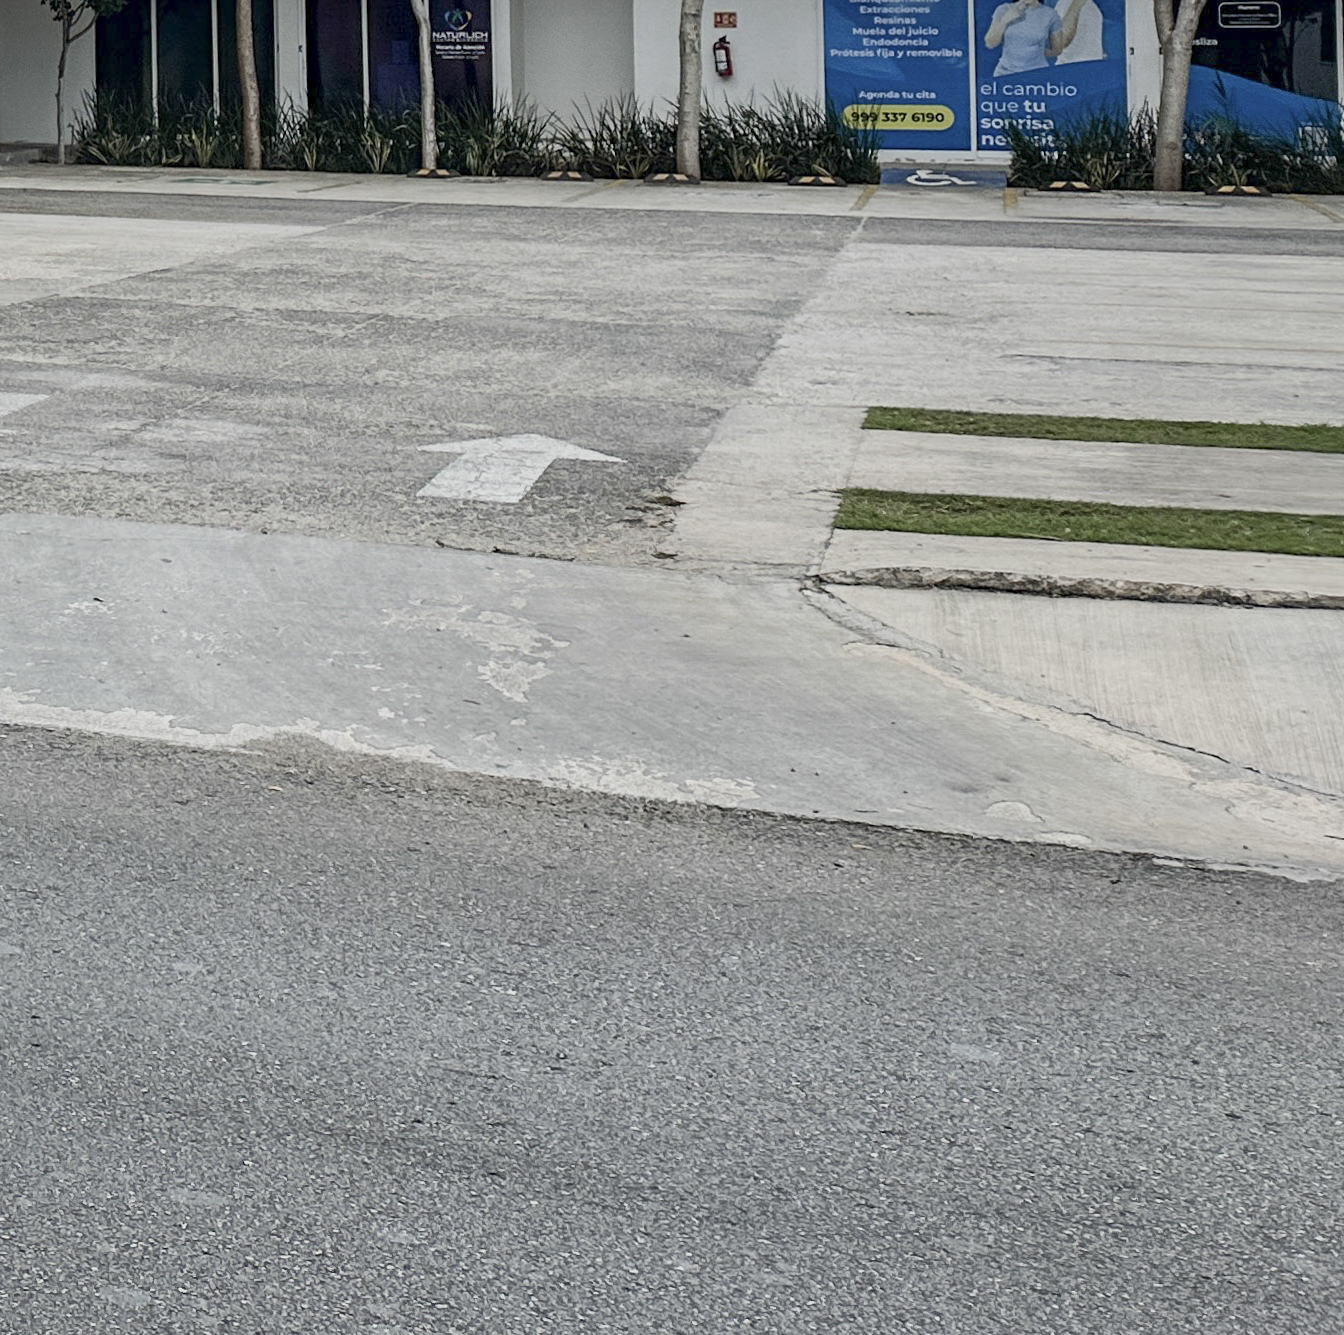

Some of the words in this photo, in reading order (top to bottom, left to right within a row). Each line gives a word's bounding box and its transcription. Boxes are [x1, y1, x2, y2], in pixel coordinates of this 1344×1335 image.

[860, 6, 930, 14] Extracciones
[874, 16, 917, 25] Resinas
[853, 27, 886, 36] Muela
[888, 27, 906, 36] del
[907, 27, 939, 37] juicio
[863, 38, 928, 46] Endodoncia
[830, 48, 874, 57] Prótesis
[876, 48, 895, 59] fija
[896, 51, 904, 59] y
[906, 48, 963, 57] removible
[980, 82, 996, 95] el
[1002, 82, 1077, 96] cambio
[859, 90, 900, 100] Agenda
[902, 91, 914, 99] tu
[916, 90, 936, 99] cita
[980, 101, 1019, 114] que
[1023, 100, 1046, 112] tu
[852, 111, 877, 122] 999
[881, 111, 907, 122] 337
[911, 111, 945, 123] 6190
